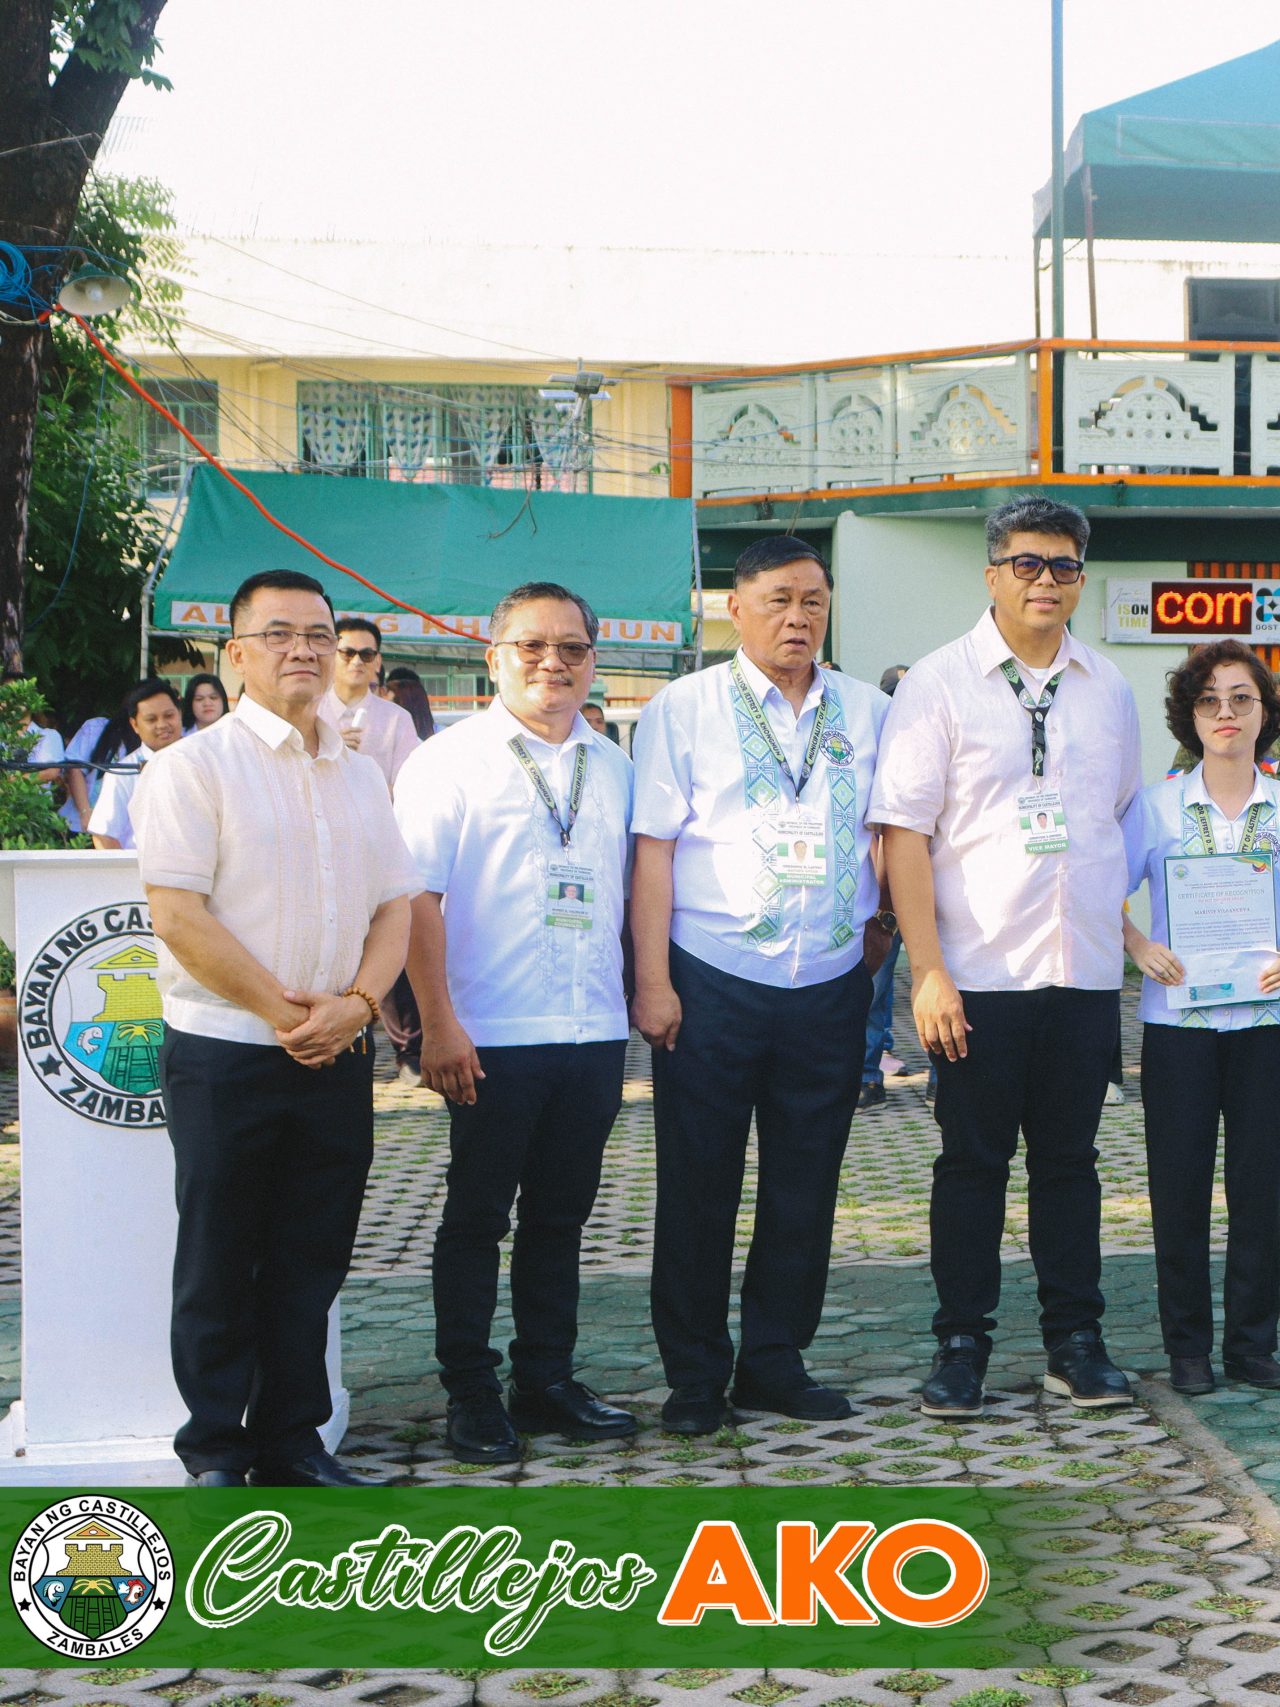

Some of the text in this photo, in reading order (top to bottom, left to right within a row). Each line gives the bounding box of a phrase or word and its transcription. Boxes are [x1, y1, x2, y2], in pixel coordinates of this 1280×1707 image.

[760, 722, 781, 756] KHONGHUN
[808, 725, 822, 760] MUNICIPALITY
[529, 767, 553, 803] KHONGHUN
[572, 765, 584, 805] MUNICIPALITY
[1200, 815, 1211, 839] JEFFREY
[24, 956, 63, 1050] BAYAN
[55, 919, 98, 957] NG
